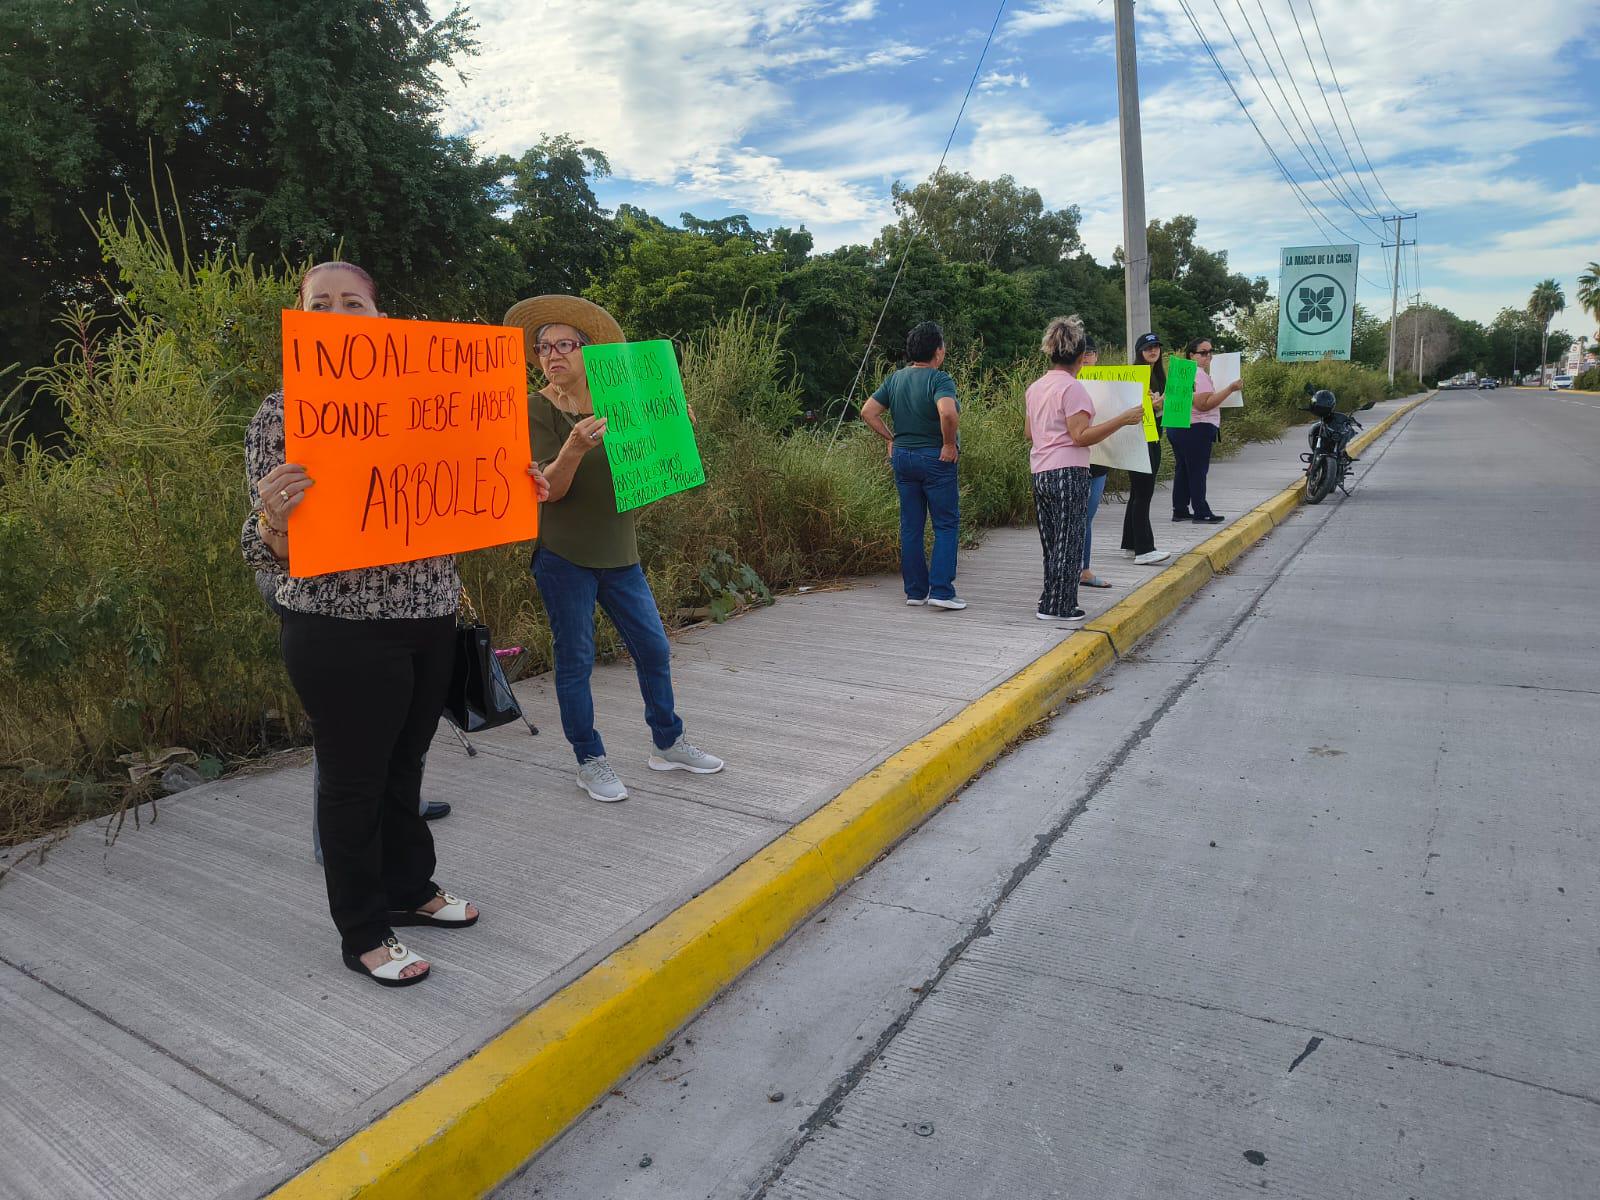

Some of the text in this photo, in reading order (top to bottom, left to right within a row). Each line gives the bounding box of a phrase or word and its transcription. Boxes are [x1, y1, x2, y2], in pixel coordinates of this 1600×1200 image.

[1286, 253, 1352, 265] LA MARCA DE LA CASA
[316, 333, 377, 380] NO
[382, 333, 419, 377] AL
[428, 335, 518, 378] CEMENTO
[293, 386, 518, 441] DONDE DEBE HABER
[361, 447, 510, 547] ARBOLES
